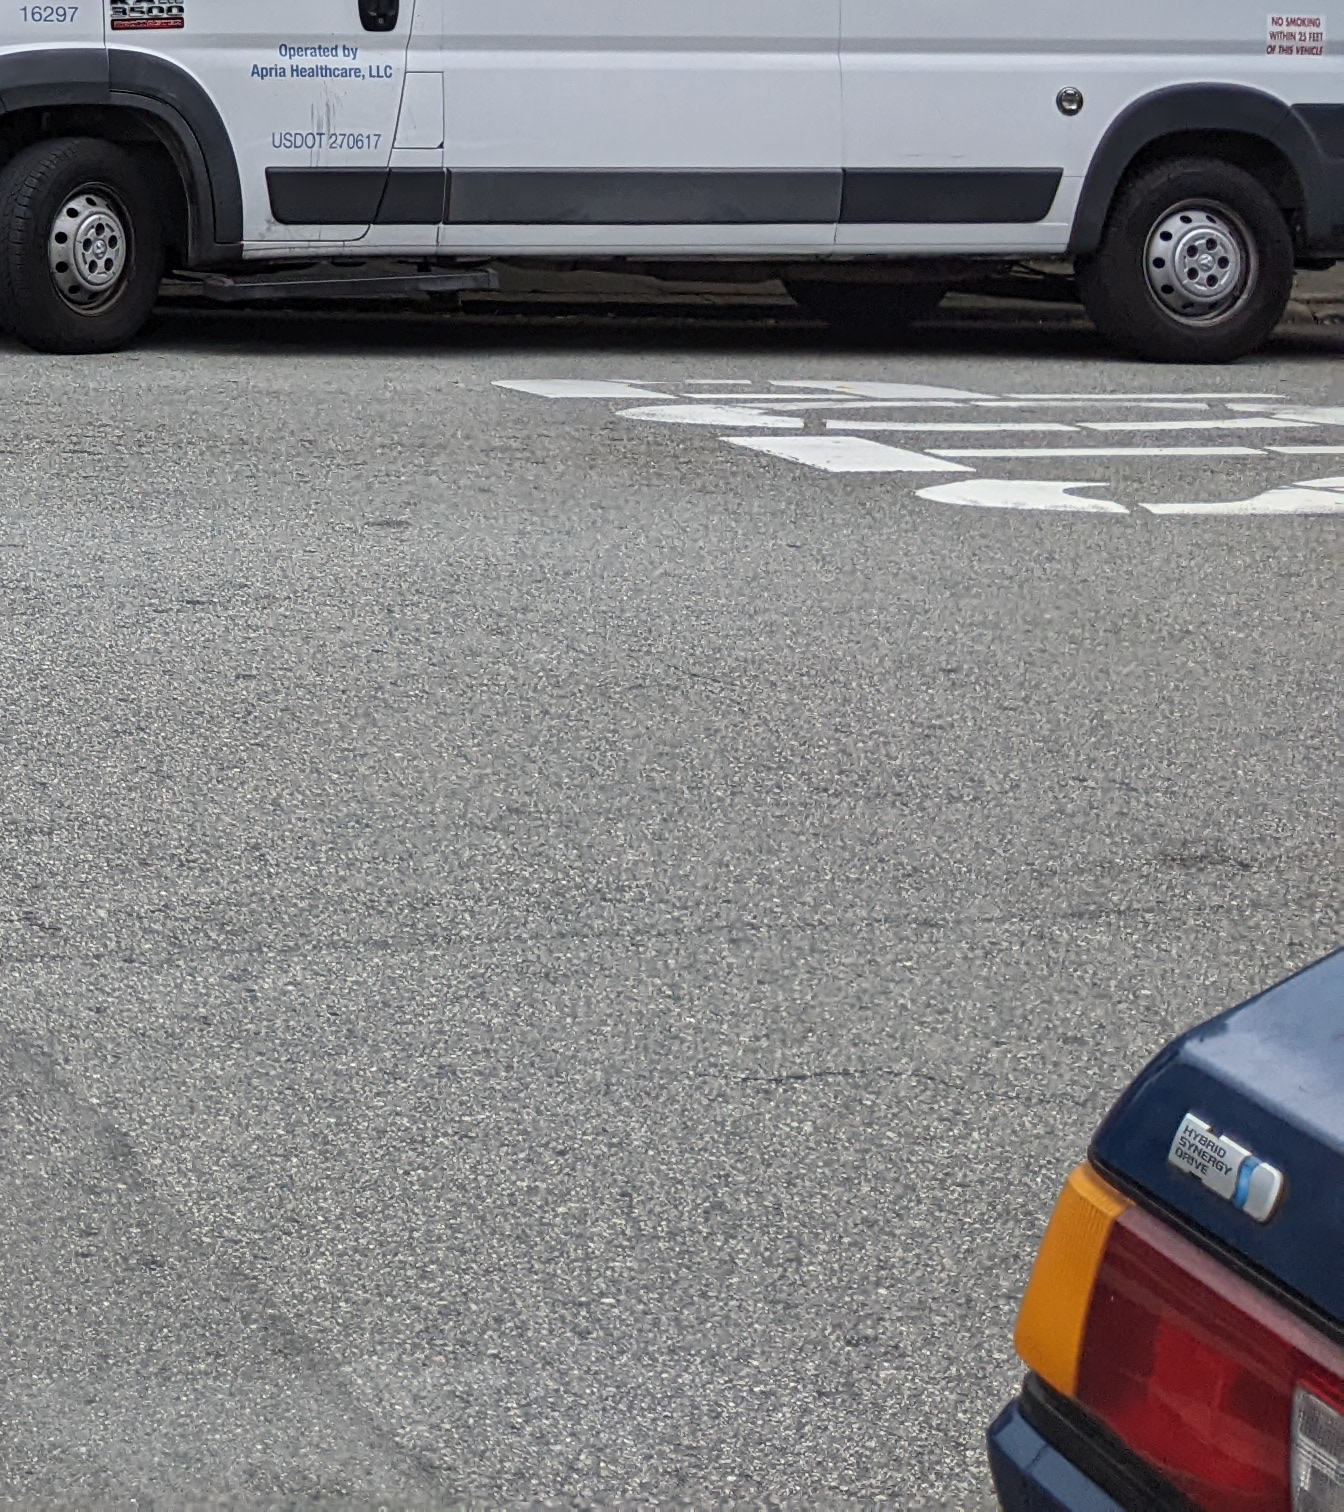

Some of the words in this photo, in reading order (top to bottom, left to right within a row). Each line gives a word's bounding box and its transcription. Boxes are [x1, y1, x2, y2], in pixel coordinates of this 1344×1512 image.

[19, 5, 79, 23] 16297
[110, 5, 185, 18] 3500
[1271, 16, 1284, 27] NO
[1285, 16, 1321, 28] SMOKING
[1269, 30, 1297, 41] WITHIN
[1308, 32, 1324, 42] FEET
[278, 43, 339, 59] Operated
[342, 44, 358, 60] by
[1266, 44, 1276, 55] OF
[1278, 45, 1294, 55] THIS
[1295, 45, 1324, 56] VEHICLE
[251, 64, 287, 80] Apria
[290, 64, 366, 80] Healthcare,
[368, 65, 393, 79] LLC
[272, 132, 325, 149] USDOT
[329, 133, 382, 150] 270617
[1183, 1125, 1227, 1159] HYBRID
[1174, 1147, 1210, 1176] DRIVE
[1178, 1135, 1233, 1176] SYNERGY
